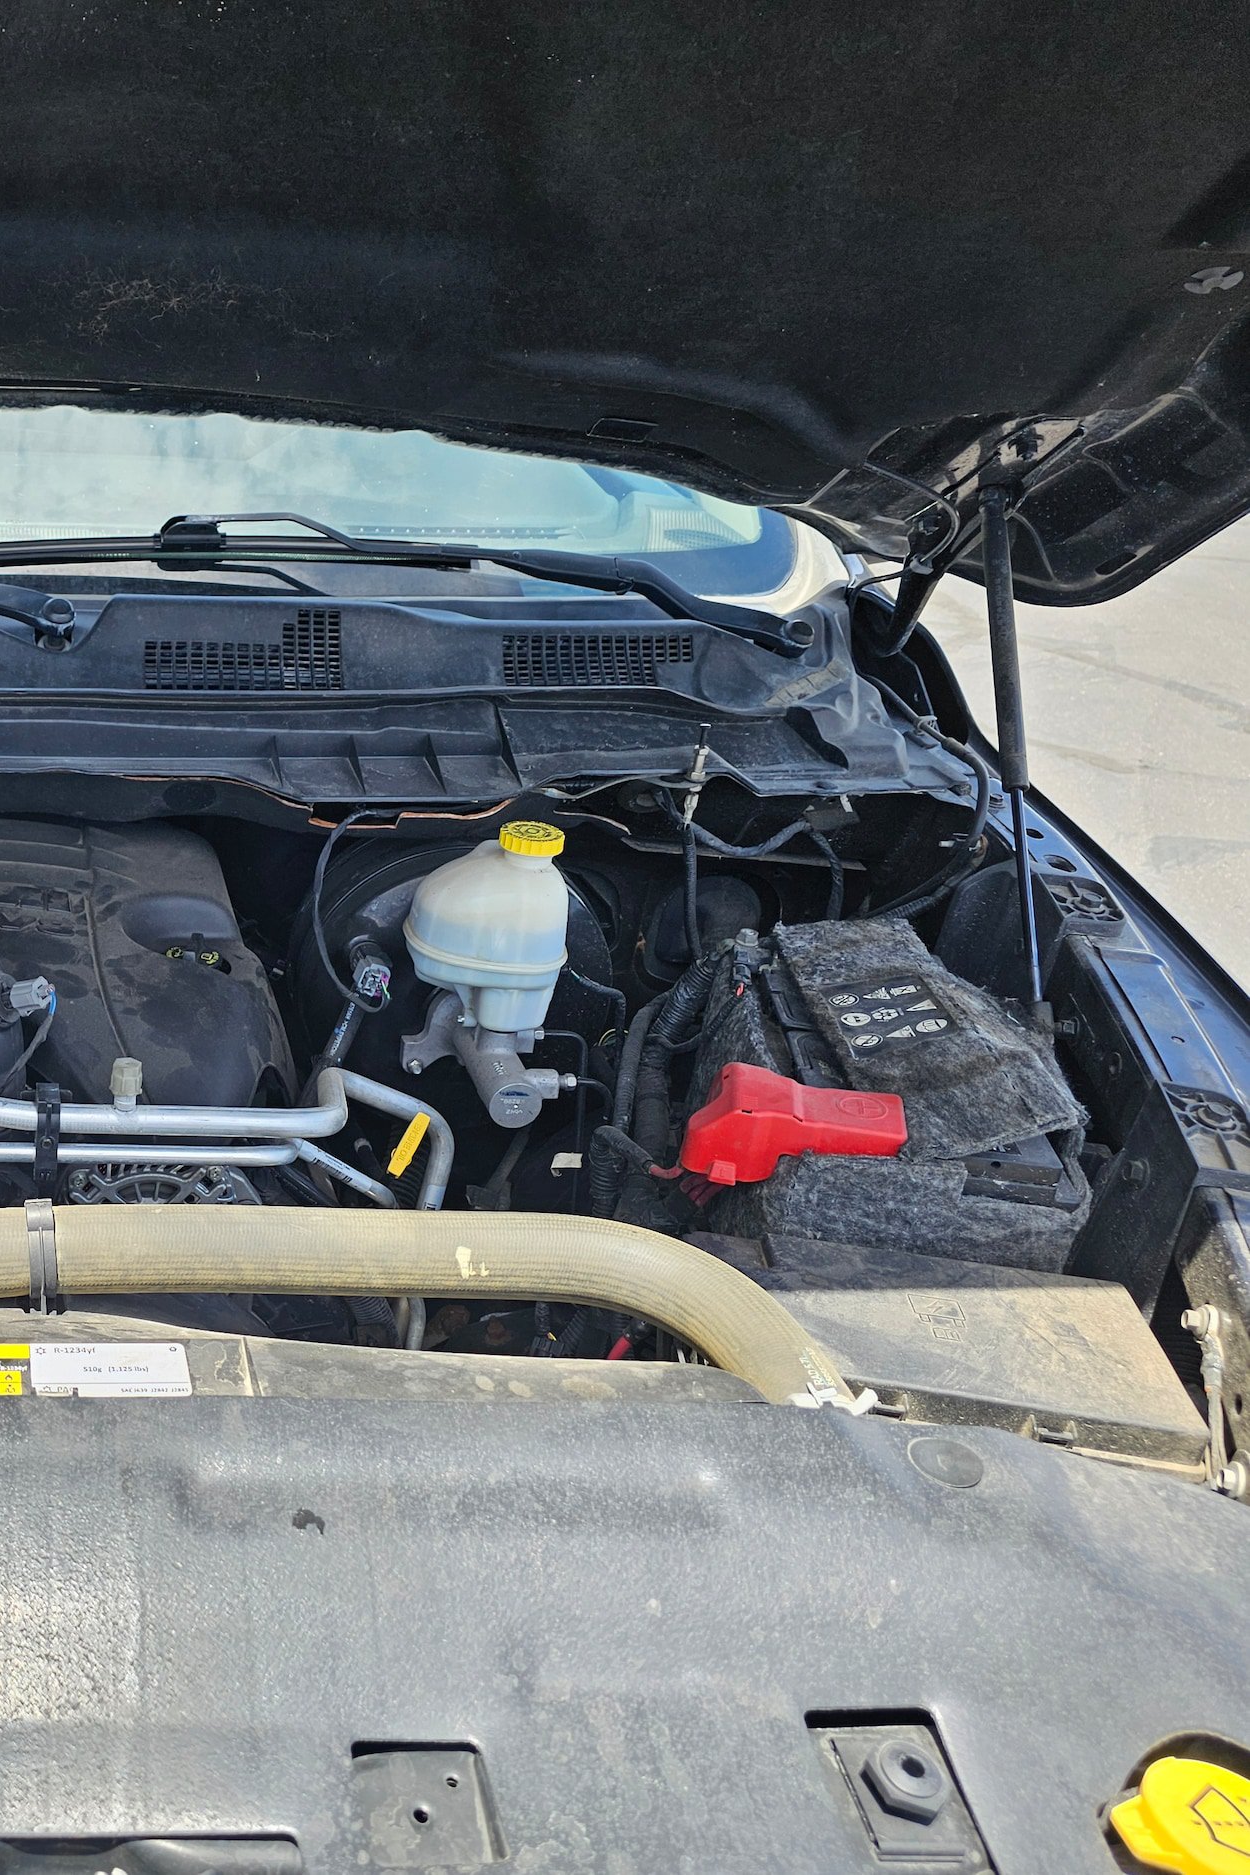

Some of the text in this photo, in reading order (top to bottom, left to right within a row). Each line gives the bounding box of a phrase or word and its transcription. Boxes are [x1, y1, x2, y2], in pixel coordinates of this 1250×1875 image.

[54, 1346, 96, 1355] R-1234yf
[83, 1366, 103, 1374] 510g
[134, 1366, 149, 1374] lbs)
